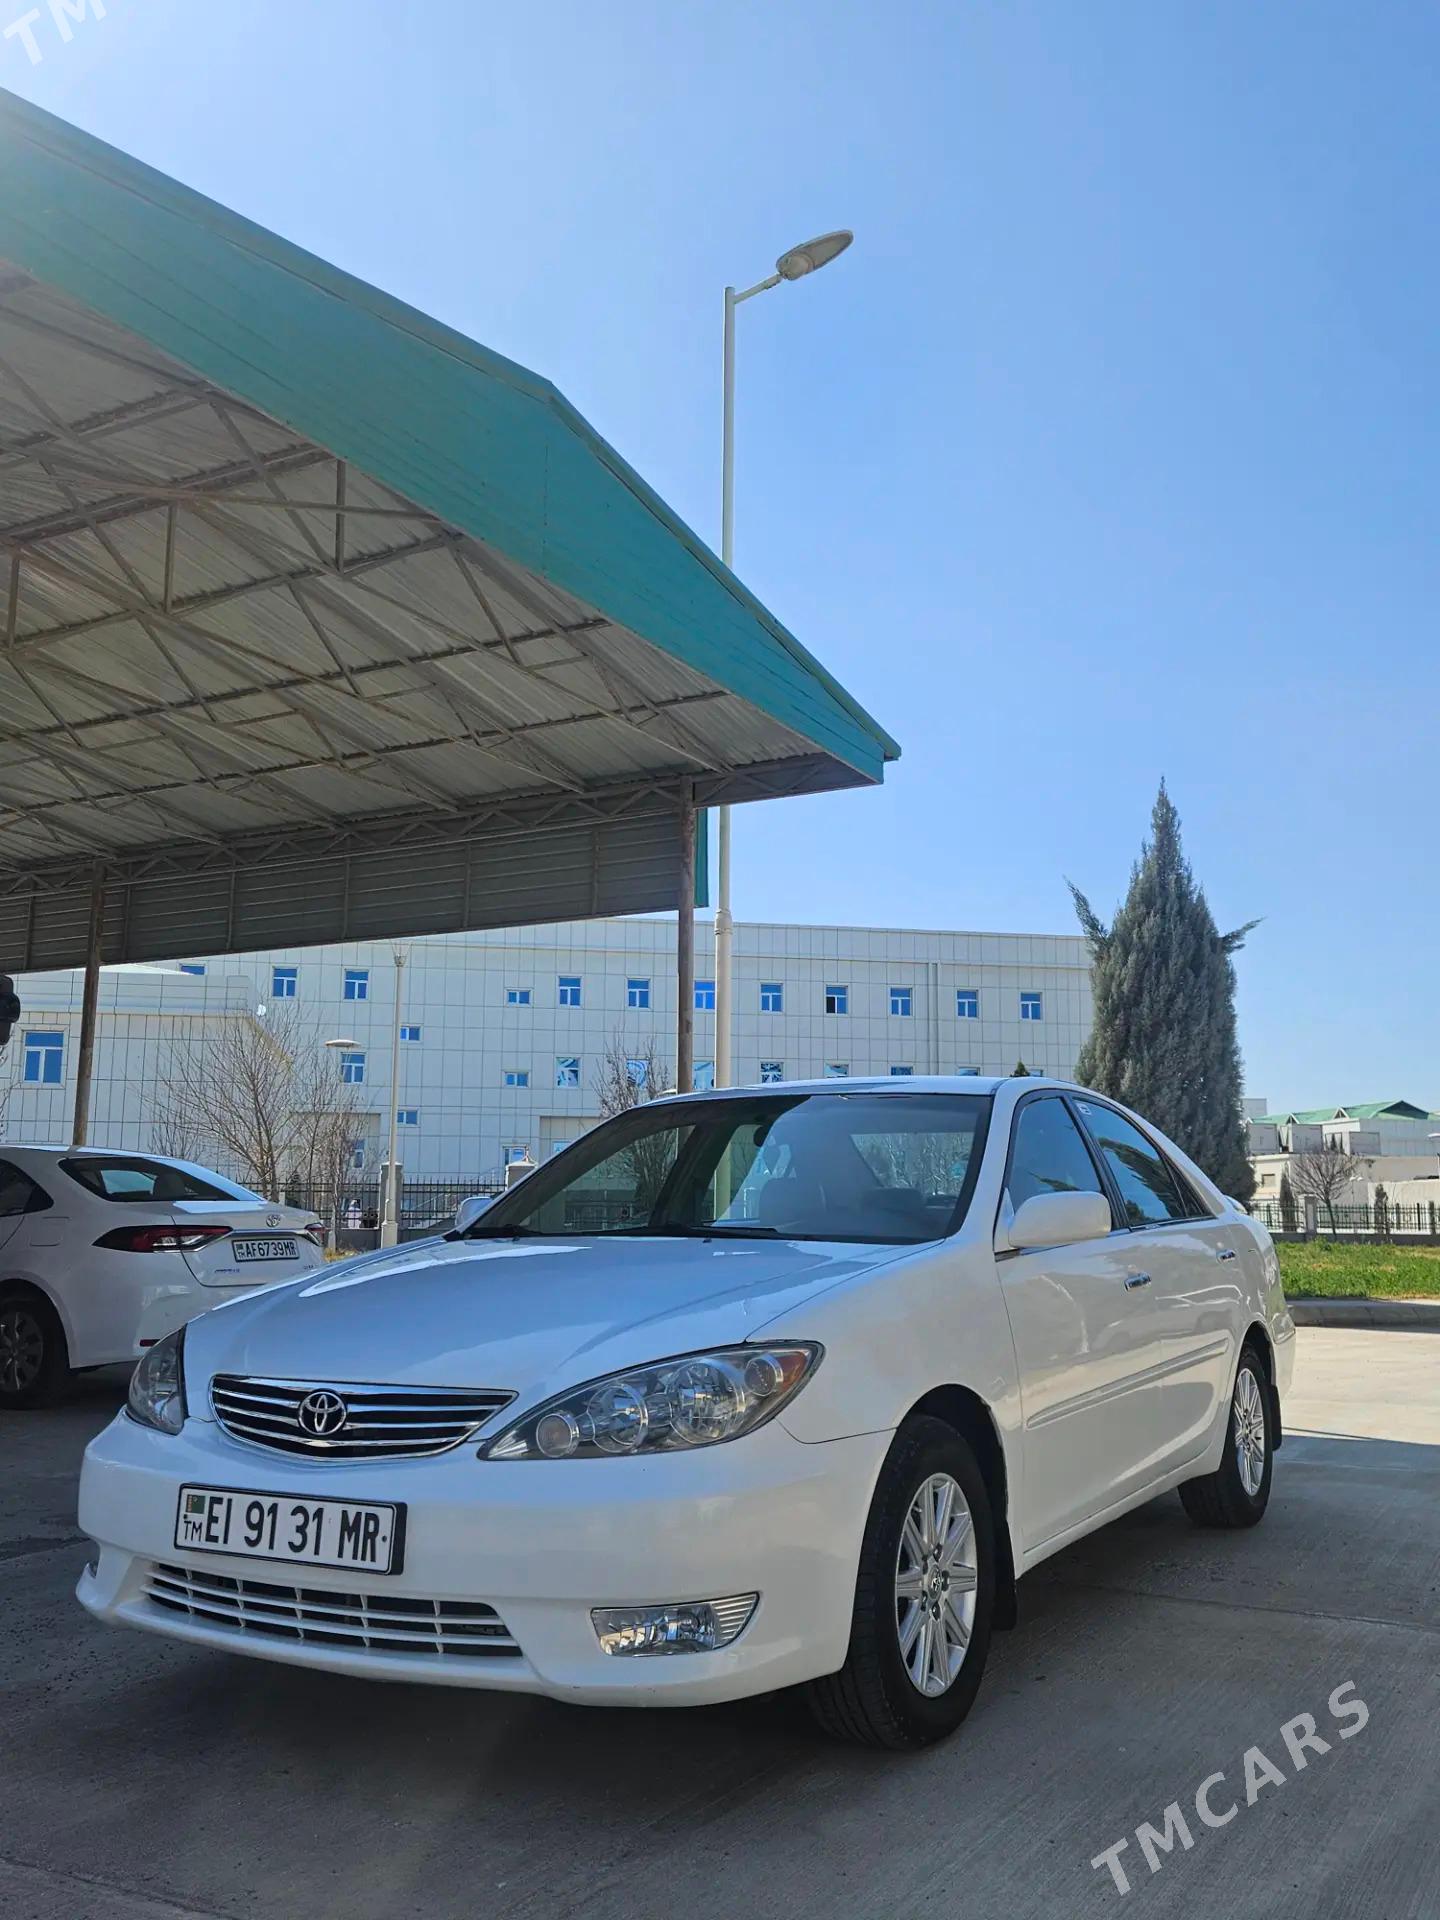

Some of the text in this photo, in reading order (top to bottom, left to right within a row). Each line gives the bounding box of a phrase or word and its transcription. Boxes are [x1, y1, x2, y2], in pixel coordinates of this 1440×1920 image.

[183, 1520, 203, 1542] TM
[205, 1496, 380, 1562] EI 91 31 MR
